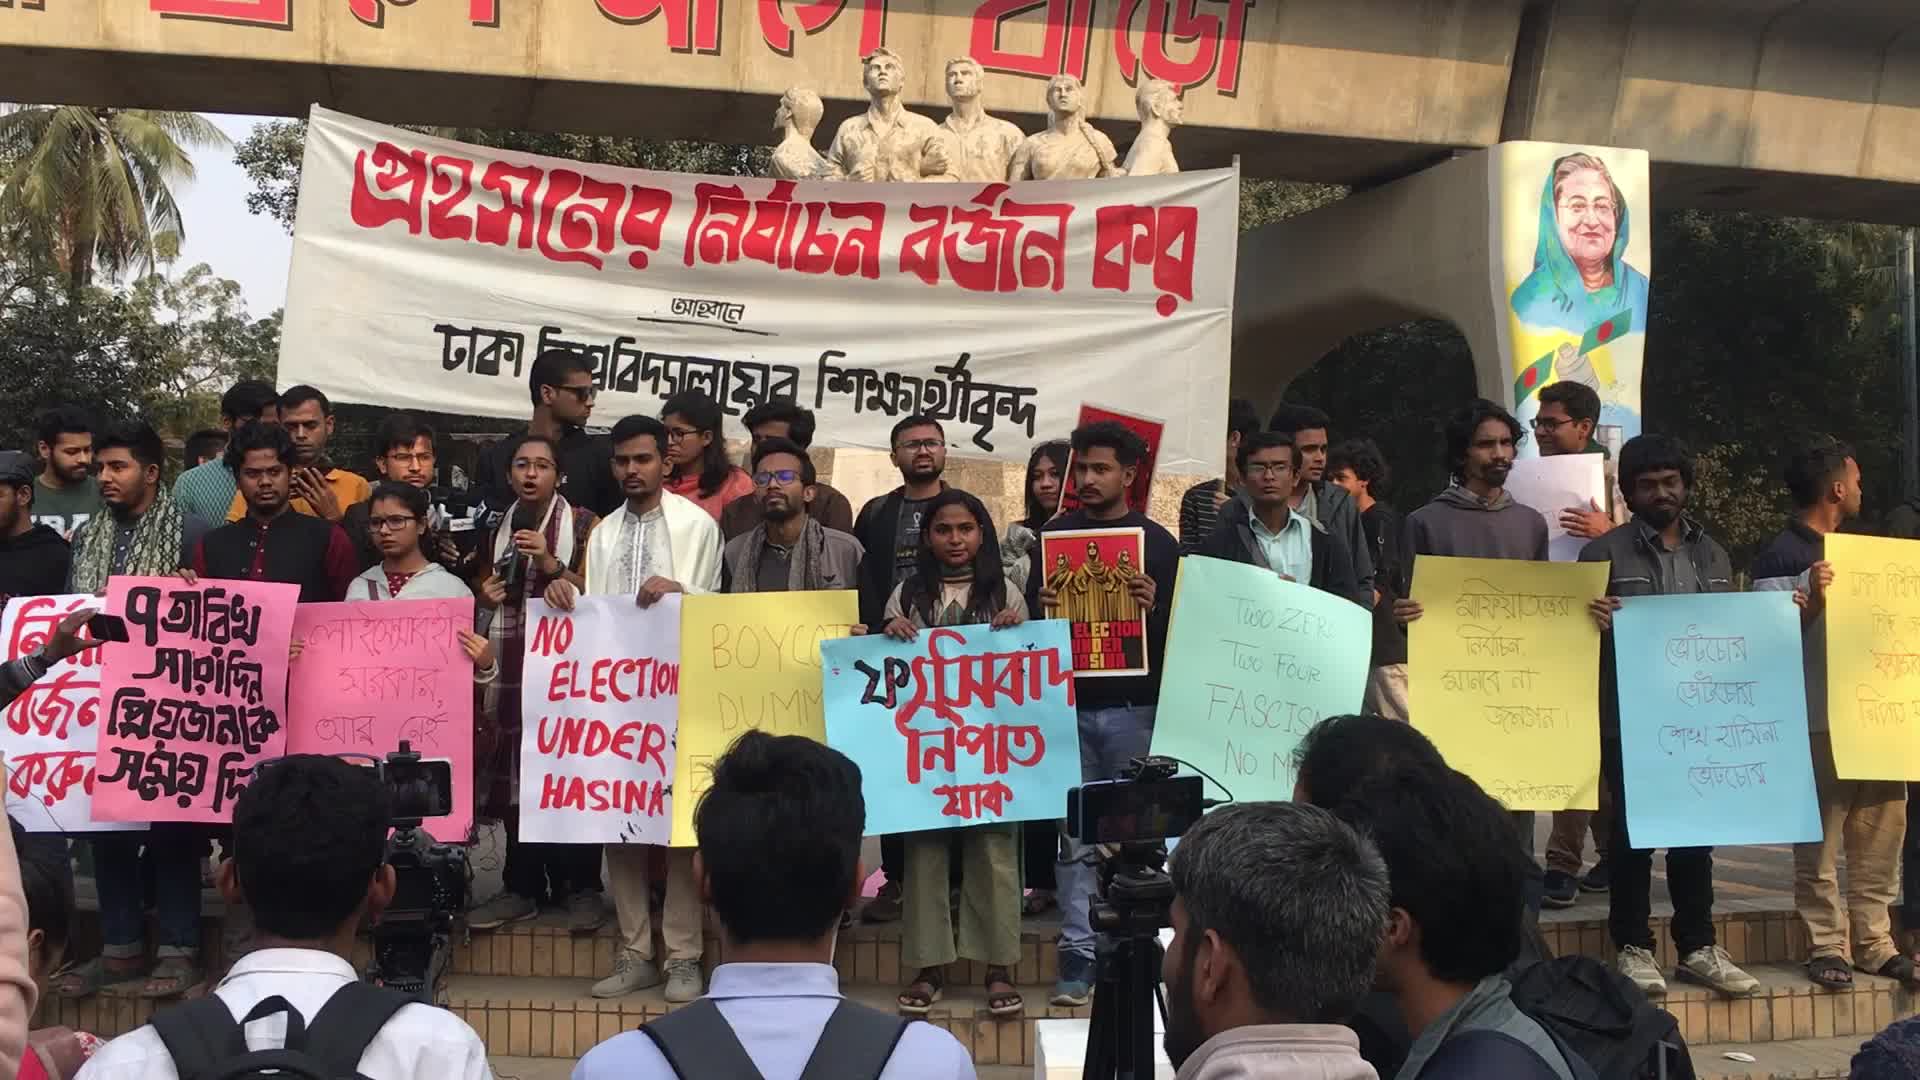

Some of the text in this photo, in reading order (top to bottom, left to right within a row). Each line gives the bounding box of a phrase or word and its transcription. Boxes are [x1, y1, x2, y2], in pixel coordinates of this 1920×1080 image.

[351, 142, 1199, 317] প্রহসনের নির্বাচন বর্জন কর
[434, 325, 526, 377] ঢাকা
[815, 351, 1038, 452] শিক্ষার্থীবৃন্দ
[125, 586, 261, 646] ৭ তারিখ
[531, 616, 574, 656] NO
[132, 647, 263, 704] সারাদিন
[548, 657, 680, 703] ELECTION
[536, 716, 667, 778] UNDER
[895, 700, 1047, 784] নিপাত
[98, 742, 208, 808] সময়
[539, 773, 665, 818] HASINA
[932, 780, 1013, 818] যাক
